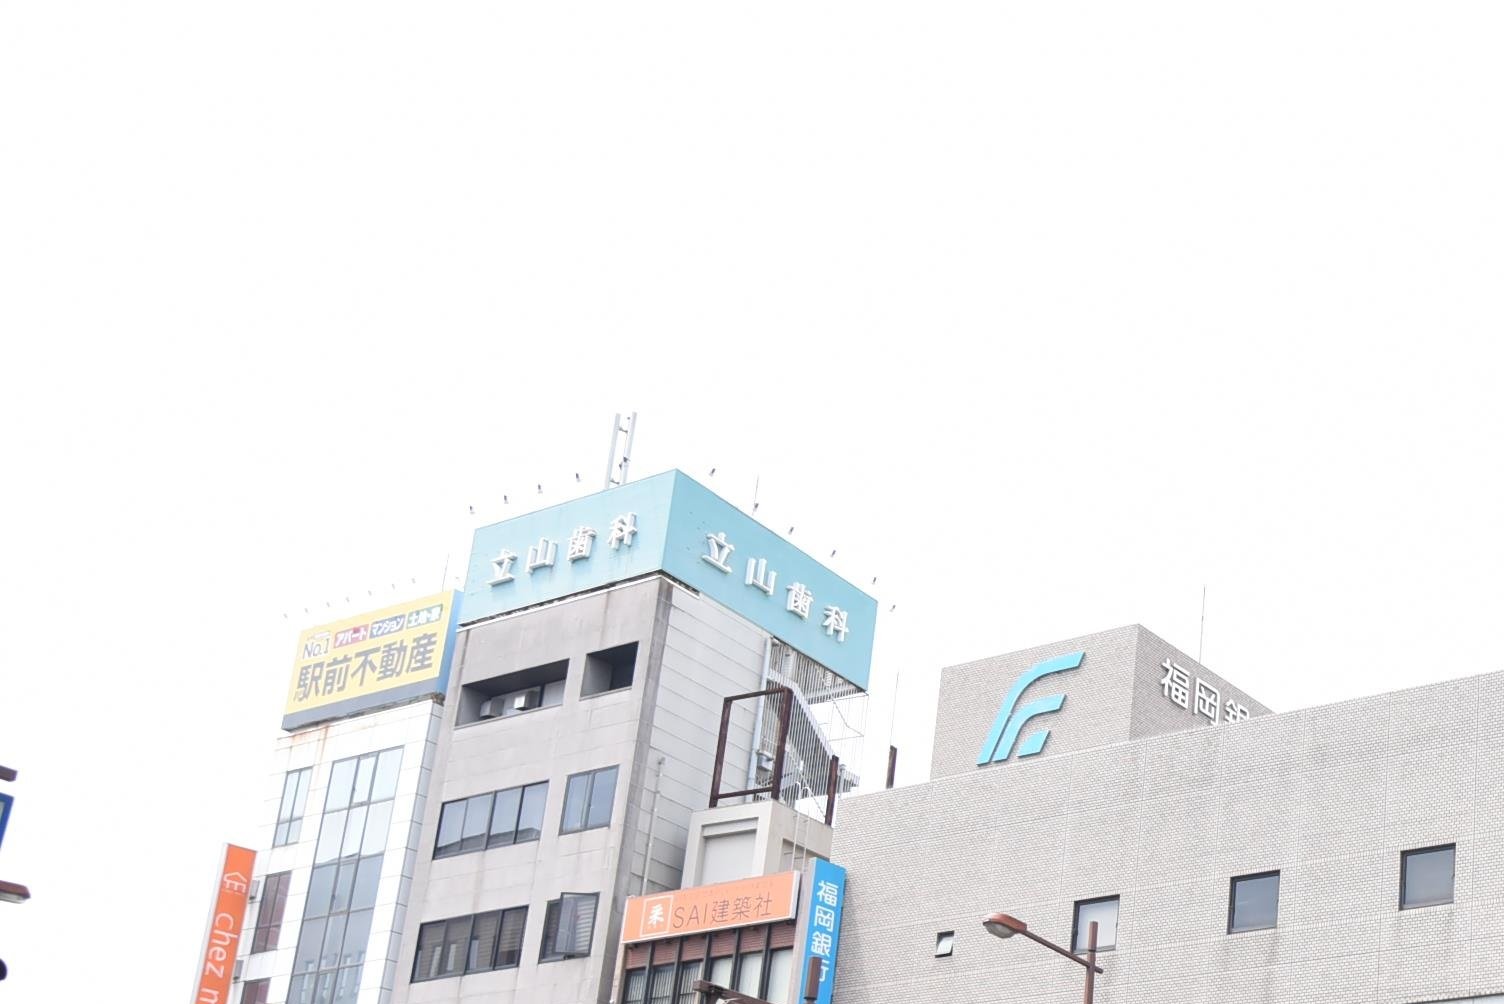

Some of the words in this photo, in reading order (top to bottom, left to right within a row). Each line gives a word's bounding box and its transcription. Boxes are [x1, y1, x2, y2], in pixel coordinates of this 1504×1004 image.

[487, 511, 638, 586] 立山歯科
[702, 531, 849, 642] 立山歯科
[294, 632, 437, 701] 駅前不動産
[673, 891, 773, 929] SAI建築社
